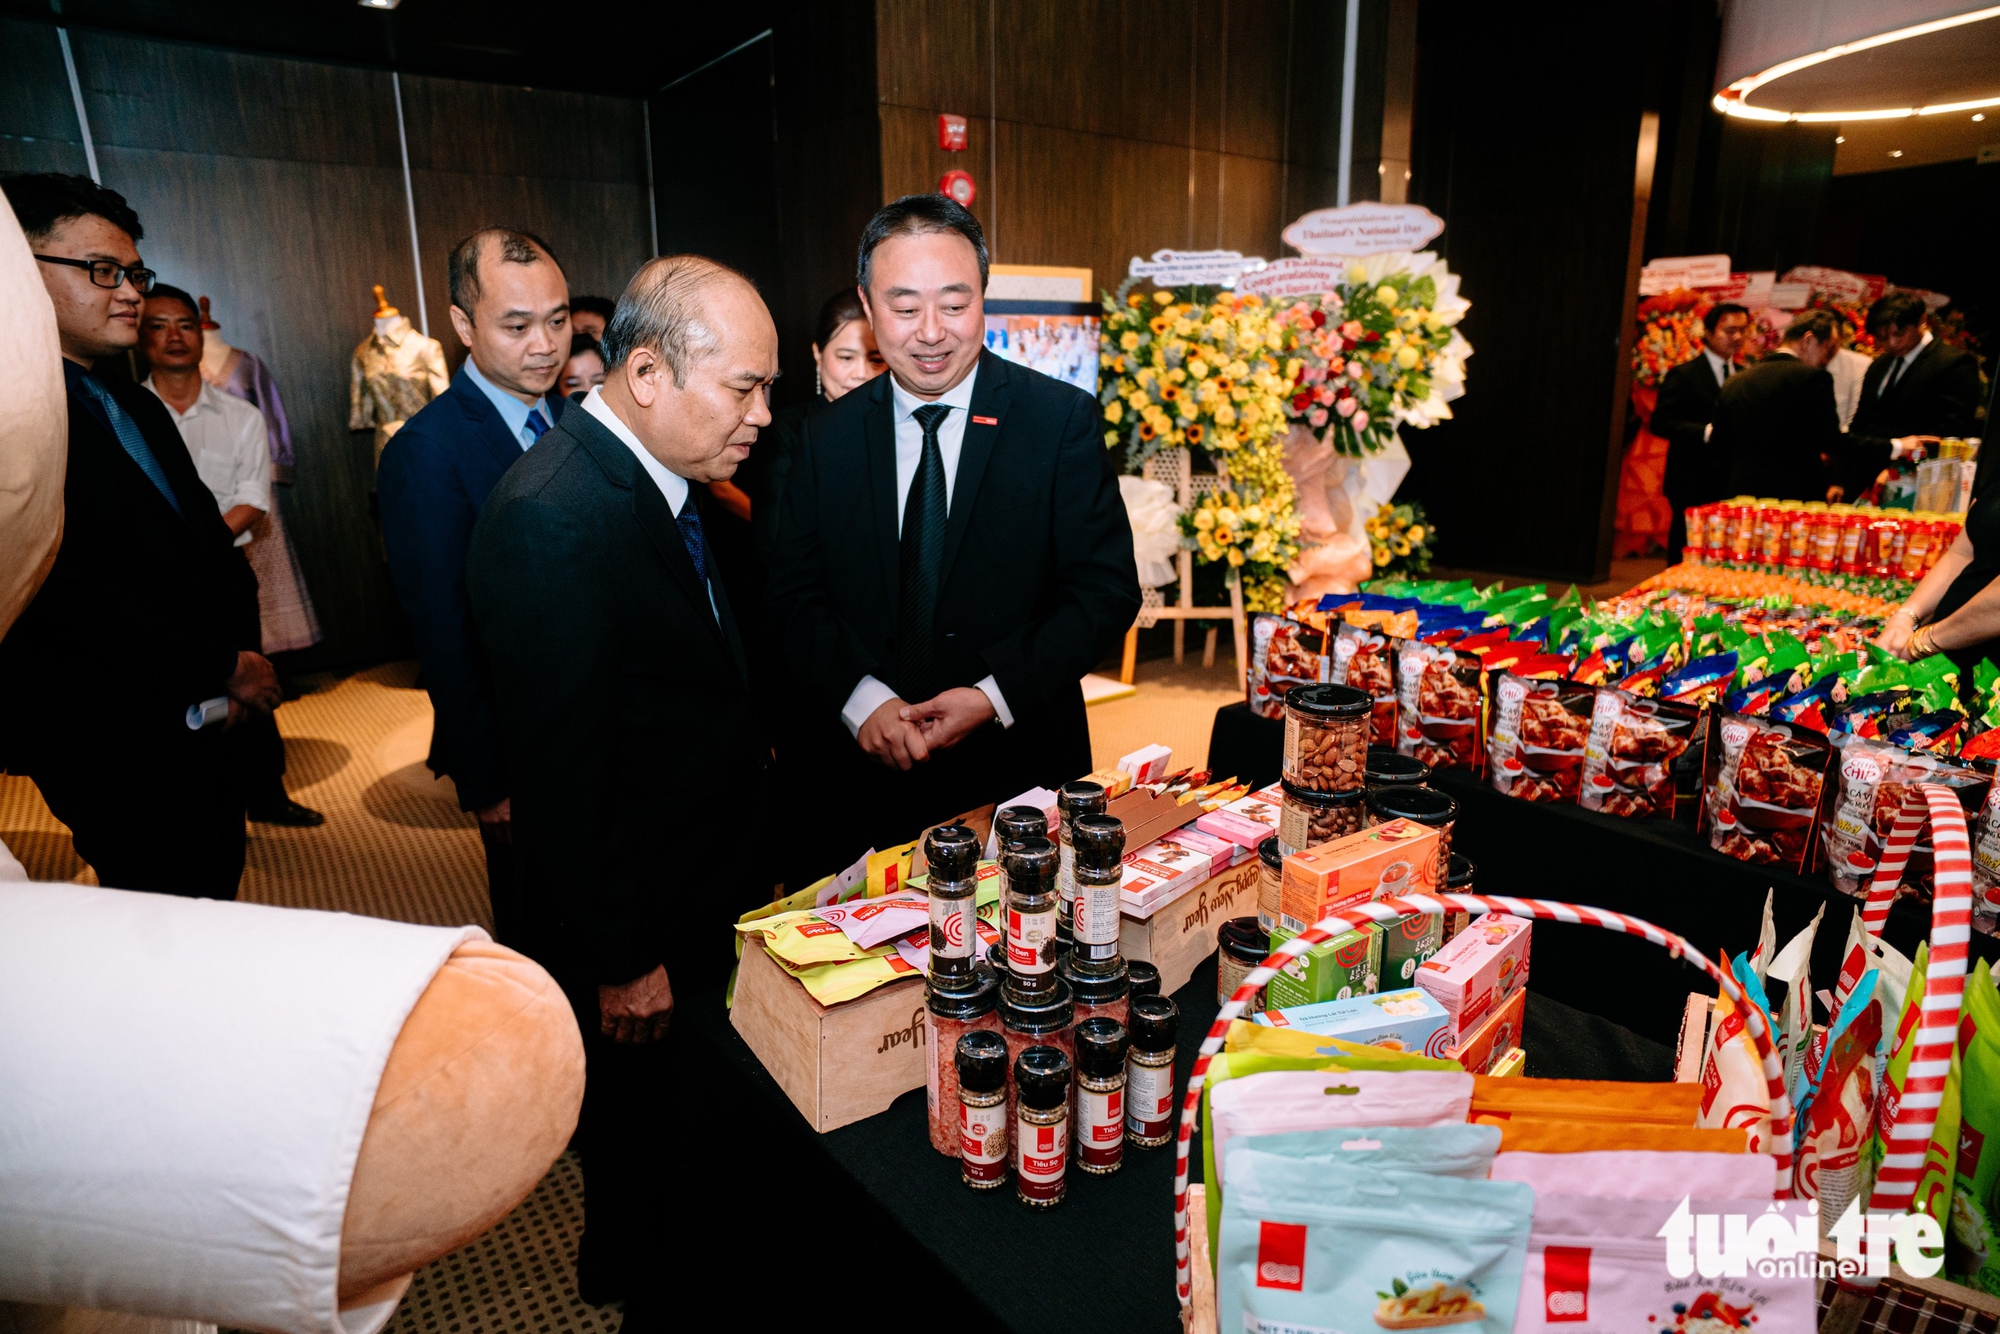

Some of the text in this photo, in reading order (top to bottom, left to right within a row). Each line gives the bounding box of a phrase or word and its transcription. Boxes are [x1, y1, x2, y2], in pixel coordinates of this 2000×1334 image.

[1358, 225, 1400, 236] National
[1403, 223, 1422, 234] Day
[1243, 270, 1330, 291] Congratulations
[1843, 767, 1877, 781] CHIP
[1210, 887, 1234, 912] New
[1183, 891, 1209, 933] Year
[878, 1007, 926, 1054] Year
[1032, 1158, 1059, 1168] Tiêu Sọ
